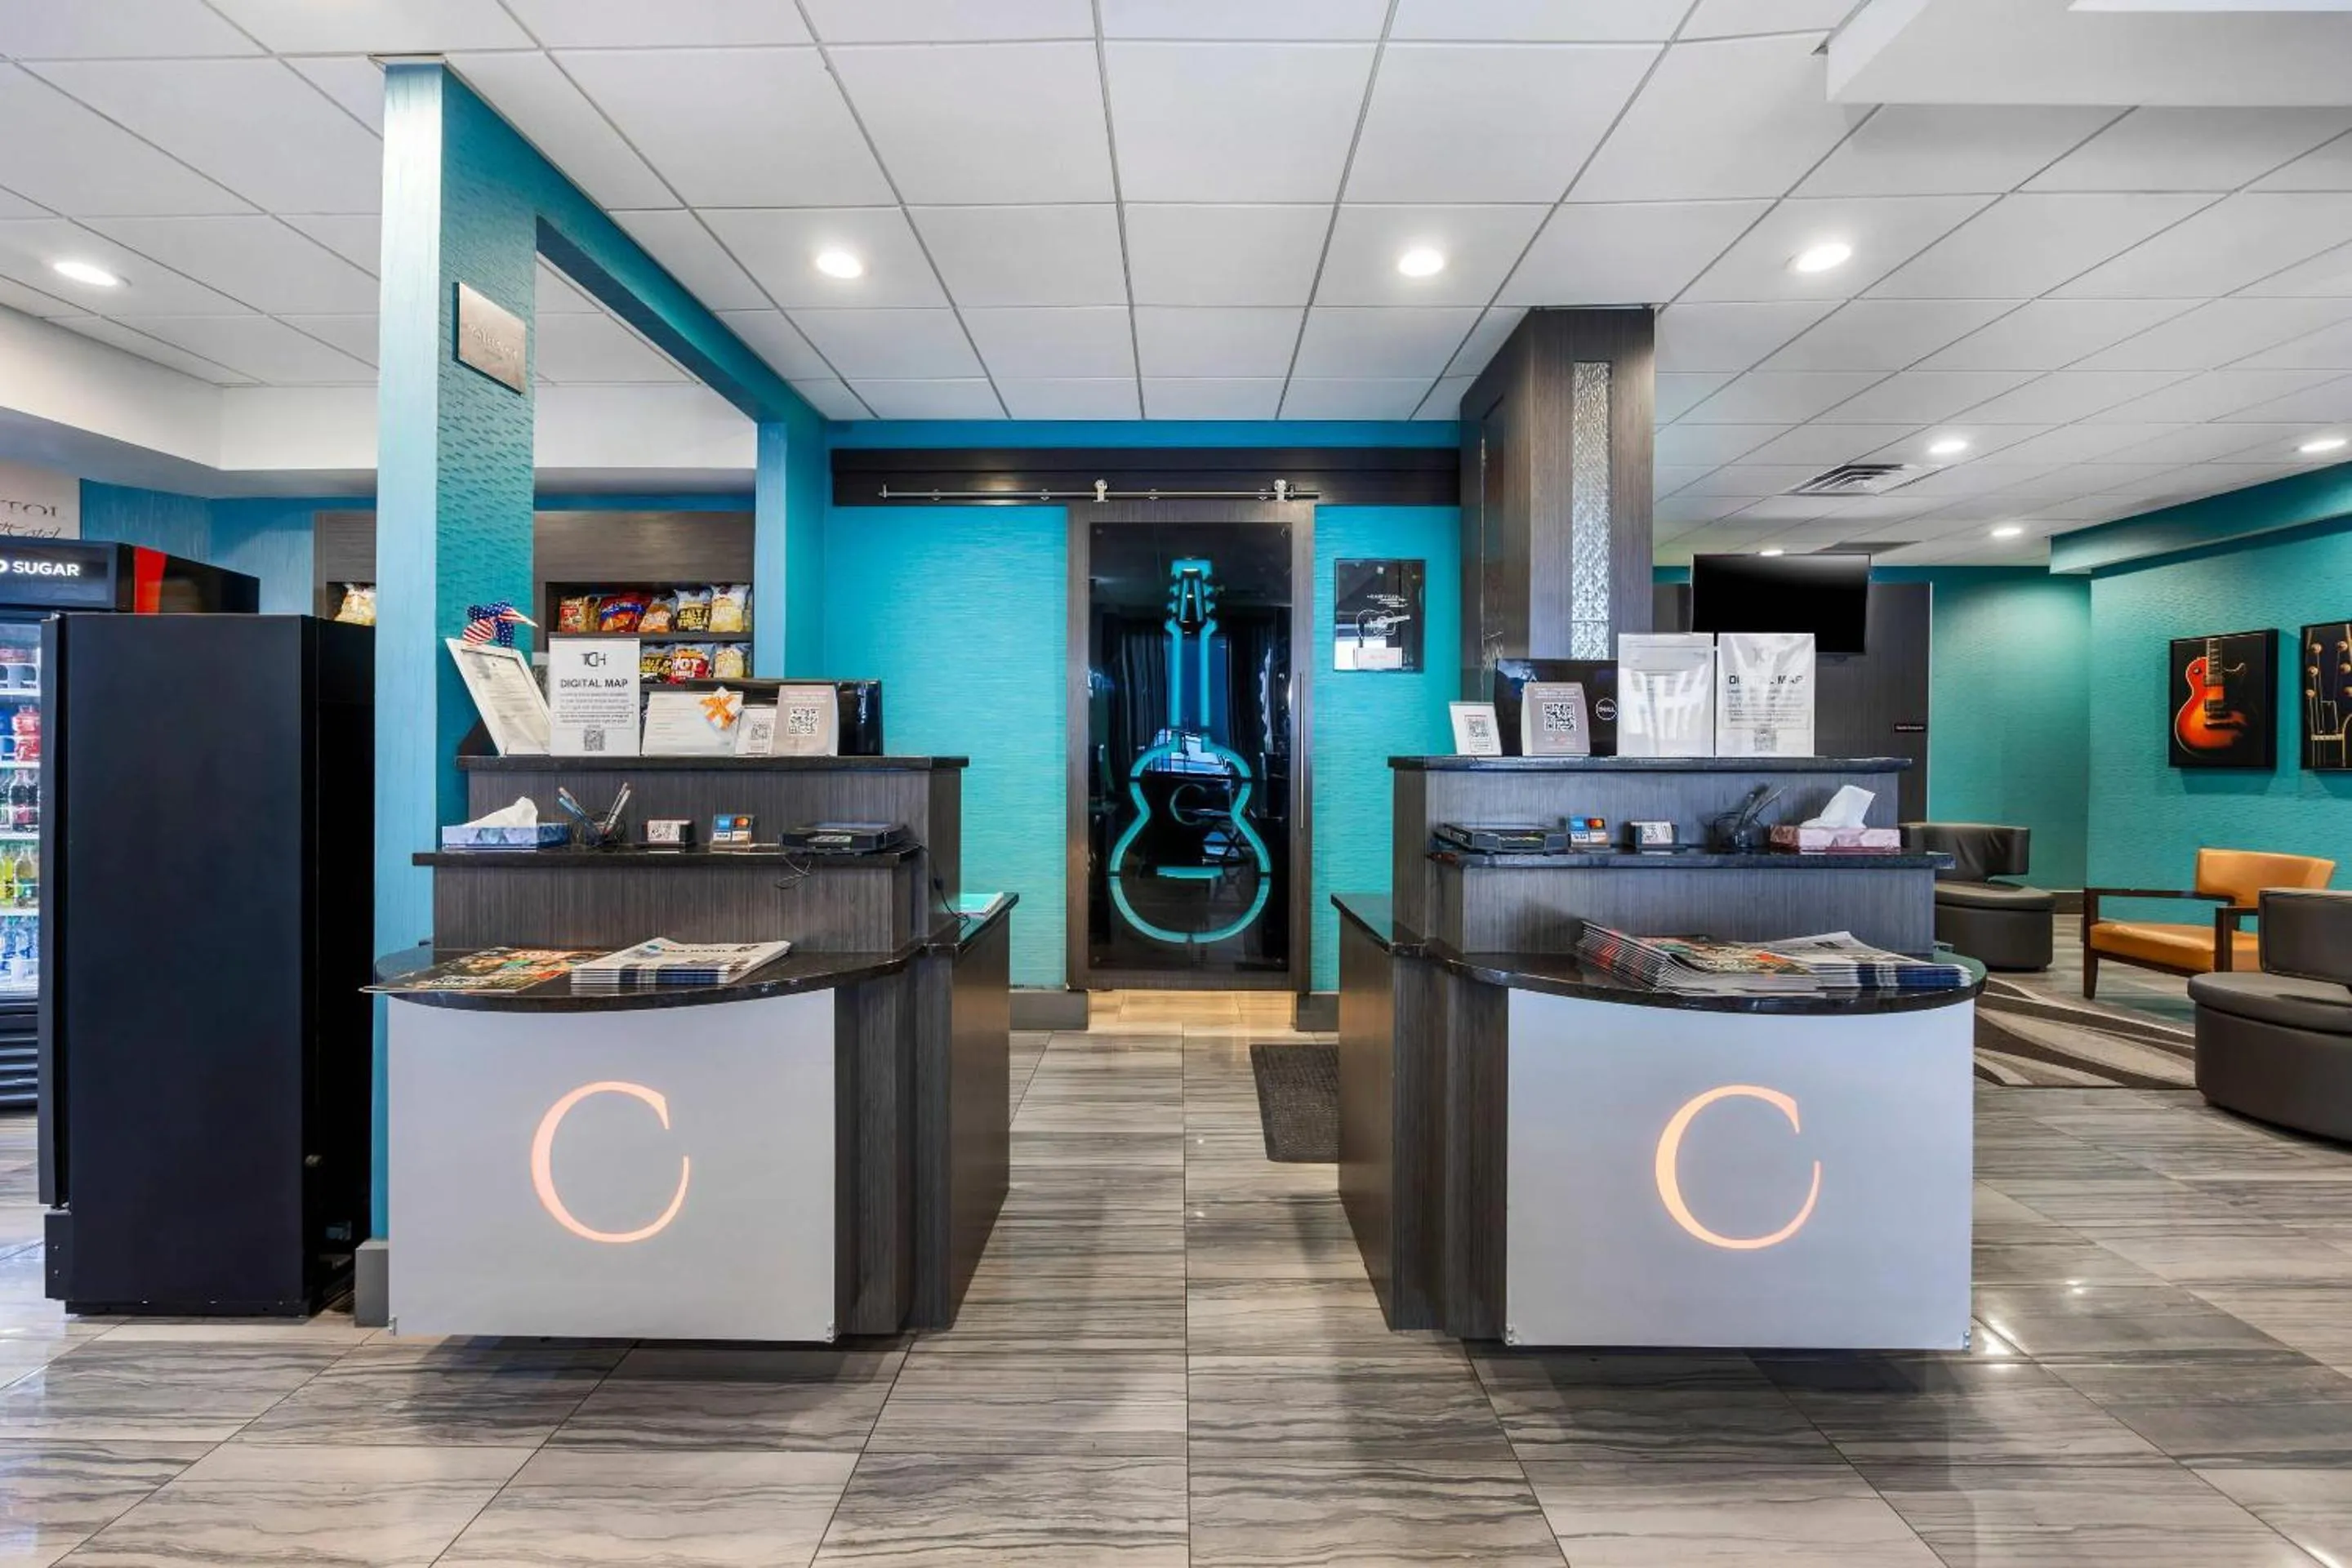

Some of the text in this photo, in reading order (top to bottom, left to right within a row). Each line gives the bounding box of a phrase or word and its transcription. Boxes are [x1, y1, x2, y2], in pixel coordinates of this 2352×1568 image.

[12, 561, 80, 577] SUGAR
[560, 679, 628, 688] DIGITAL MAP
[531, 1080, 690, 1245] C
[1655, 1085, 1820, 1250] C
